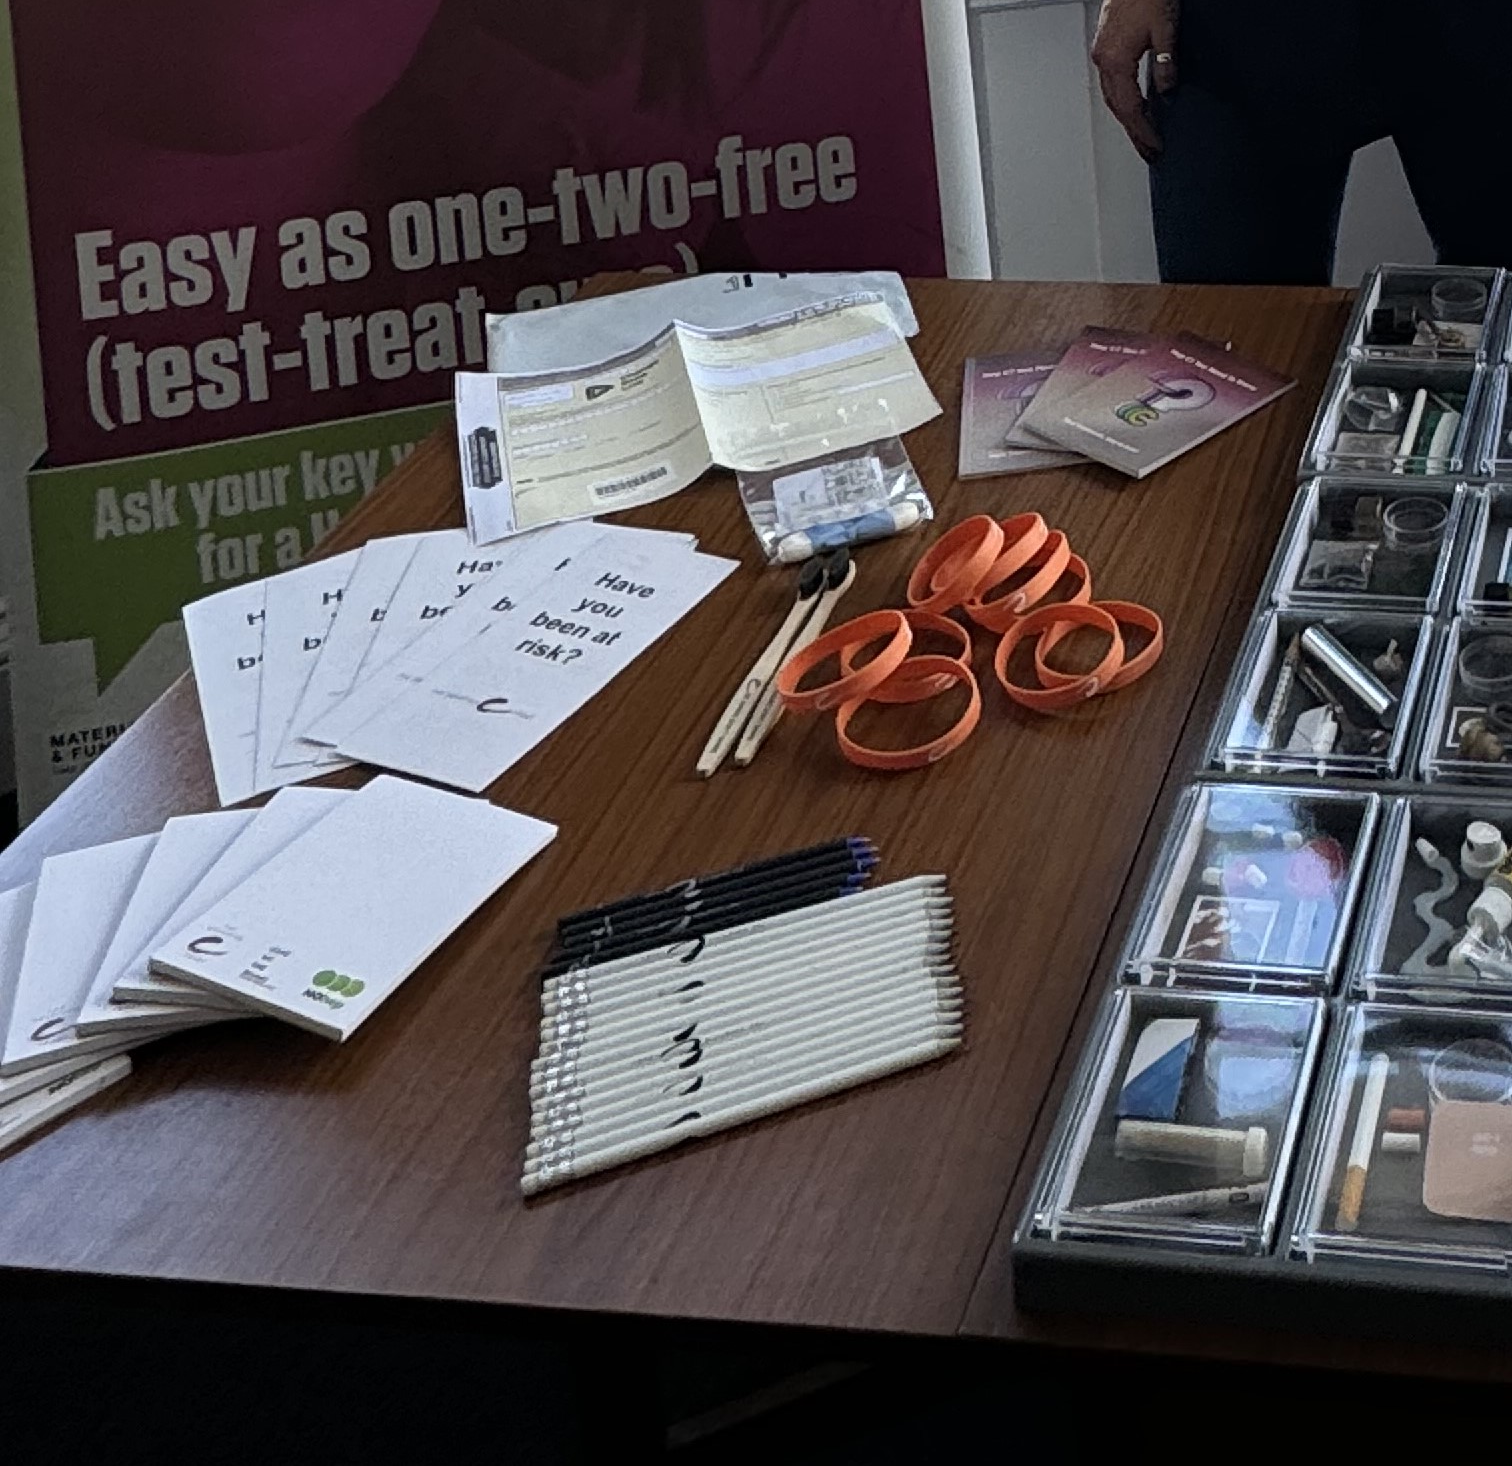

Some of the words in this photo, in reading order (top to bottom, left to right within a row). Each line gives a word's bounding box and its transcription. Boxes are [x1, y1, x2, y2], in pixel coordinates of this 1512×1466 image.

[75, 226, 256, 321] Easy
[279, 210, 371, 289] as
[389, 135, 857, 272] one-two-free
[93, 477, 180, 540] Ask
[189, 463, 292, 530] your
[301, 448, 379, 501] key
[196, 529, 264, 584] for
[275, 526, 301, 573] a
[594, 572, 656, 598] Have
[571, 597, 624, 618] you
[529, 610, 590, 639] been
[590, 630, 622, 646] at
[514, 638, 583, 665] risk?
